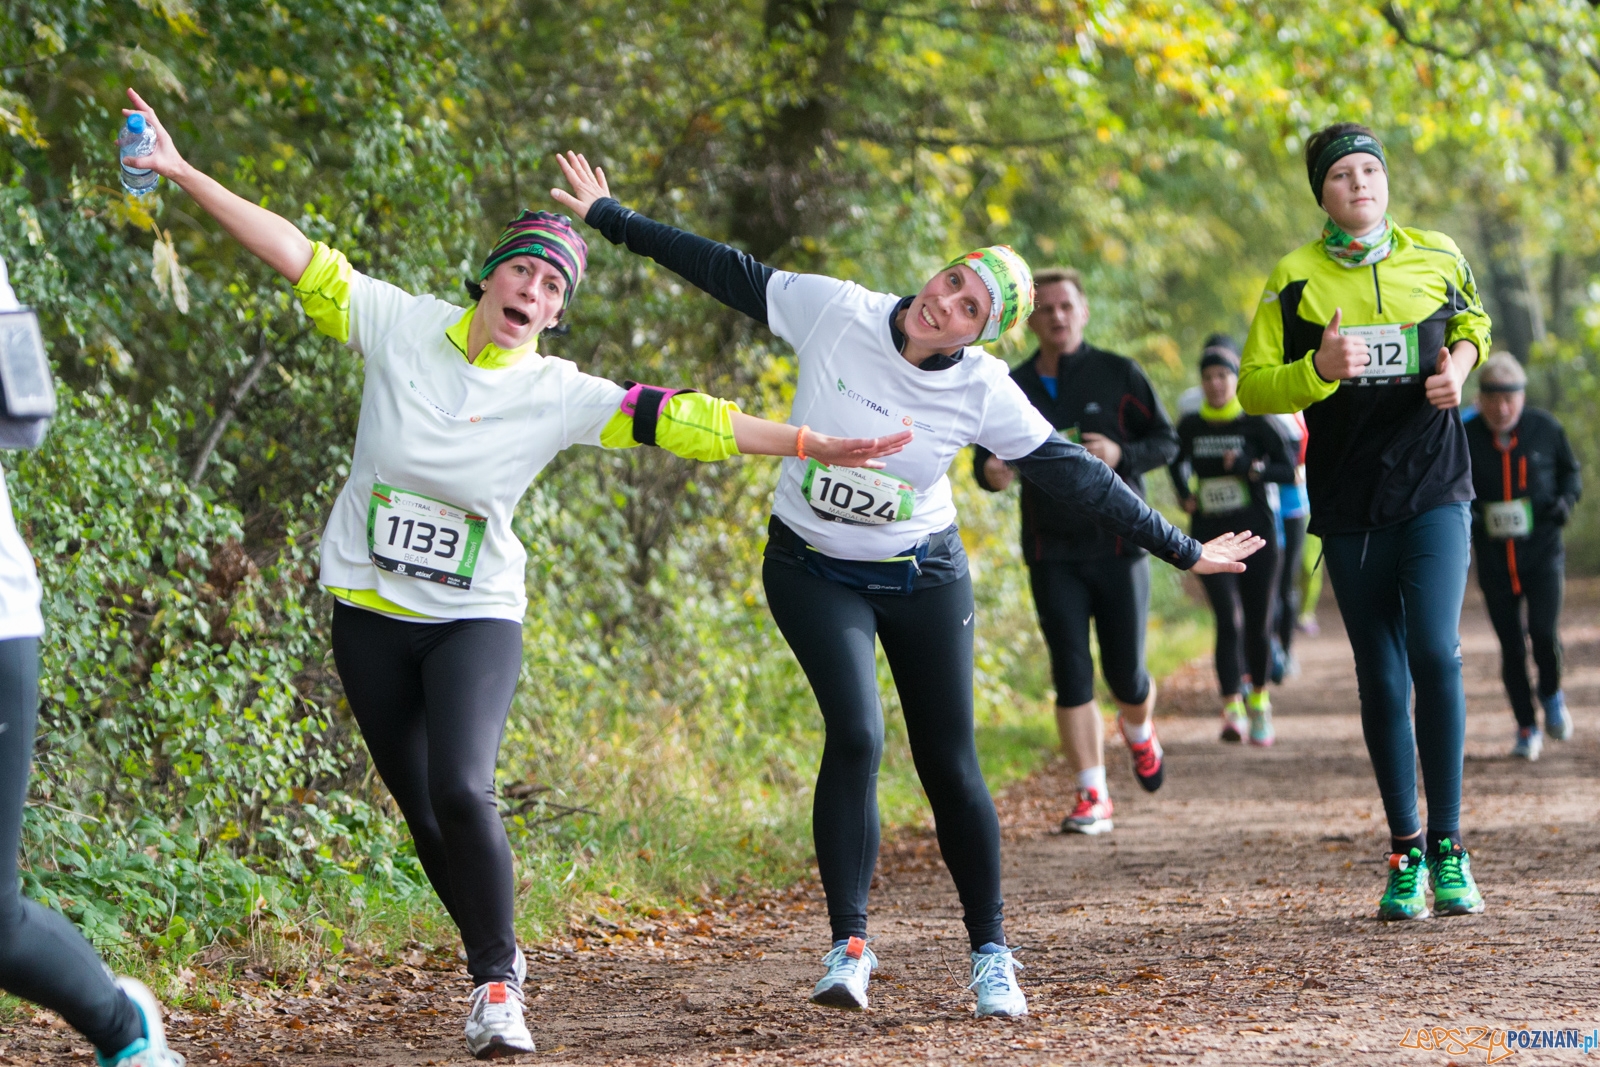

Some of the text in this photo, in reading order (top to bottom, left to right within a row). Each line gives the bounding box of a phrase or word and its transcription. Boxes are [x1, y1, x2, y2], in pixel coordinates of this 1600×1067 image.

[819, 476, 896, 522] 1024
[828, 506, 876, 524] MAGDALENA
[387, 515, 460, 559] 1133
[404, 552, 429, 566] BEATA
[464, 541, 477, 568] Poznań
